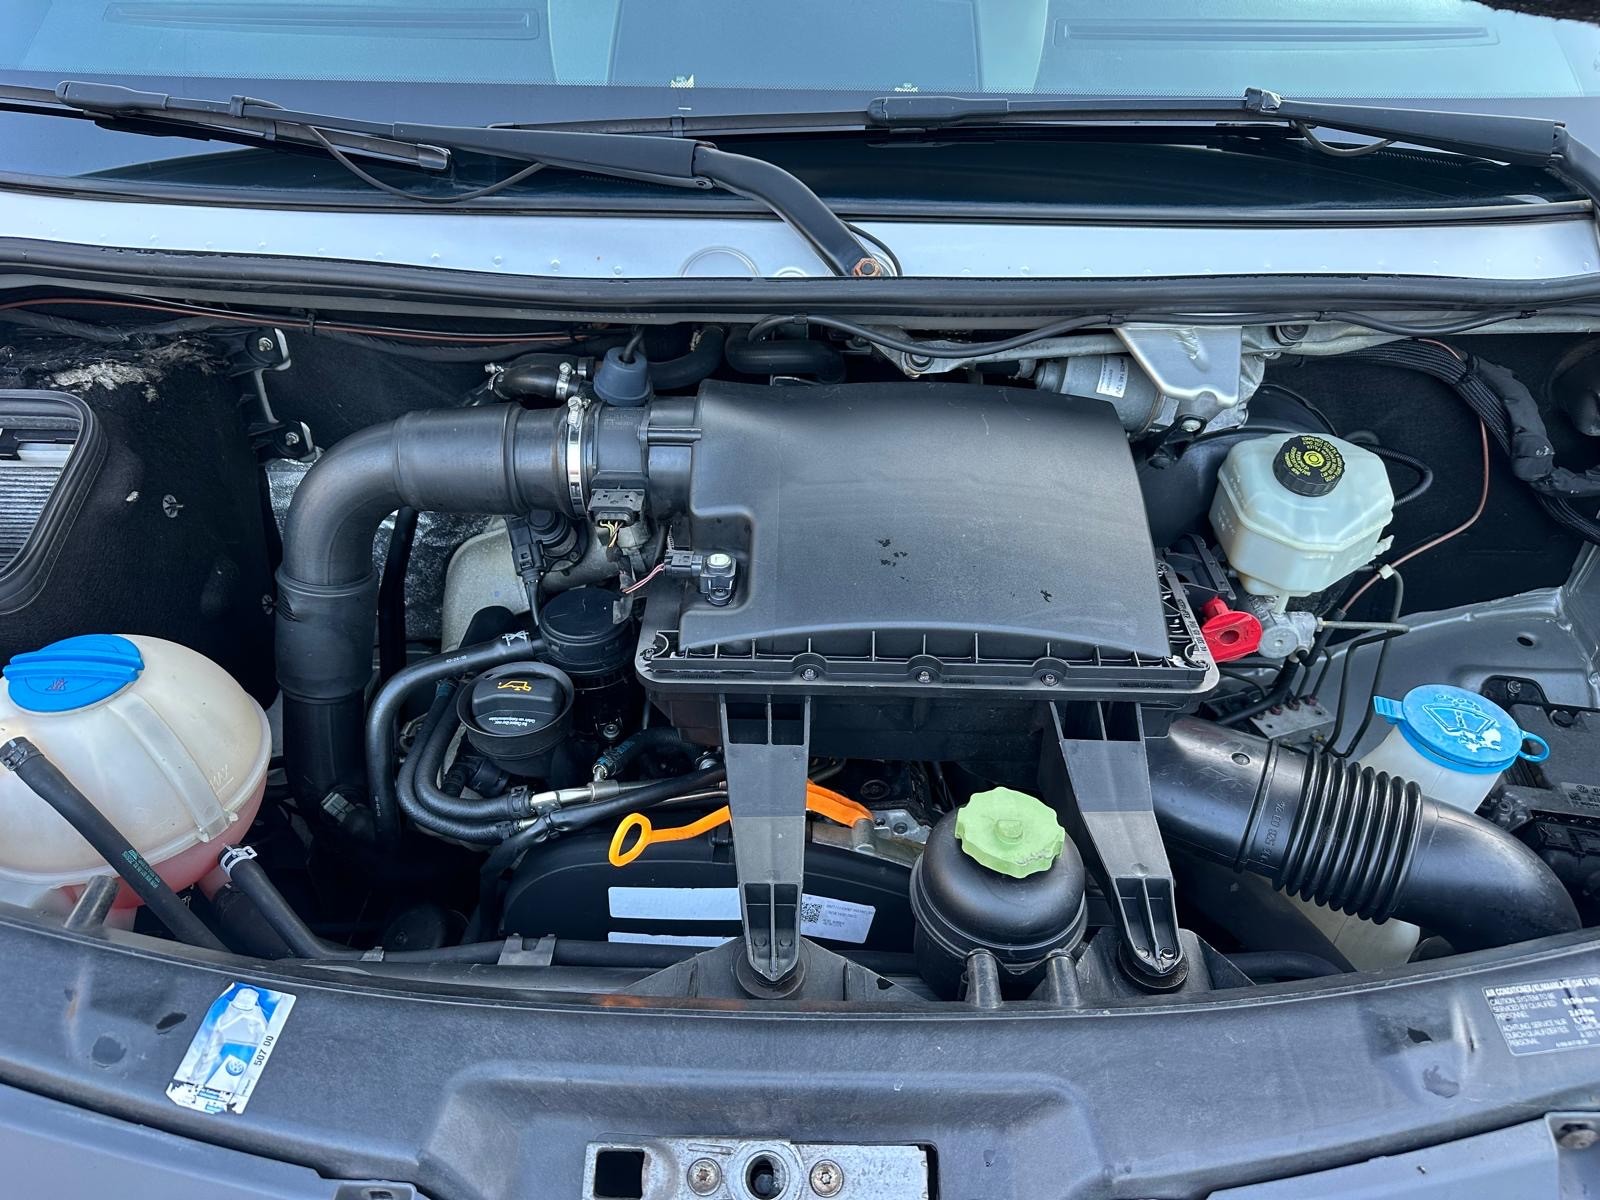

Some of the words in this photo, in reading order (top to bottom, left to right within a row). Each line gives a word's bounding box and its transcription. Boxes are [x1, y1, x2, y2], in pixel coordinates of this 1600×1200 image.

[1515, 994, 1540, 1002] SYSTEM
[1493, 1004, 1520, 1012] SERVICED
[1529, 1000, 1558, 1008] QUALIFIED
[1530, 1020, 1554, 1028] SERVICE
[1505, 1030, 1526, 1038] DURCH
[253, 1049, 268, 1067] 507
[262, 1034, 275, 1049] 00
